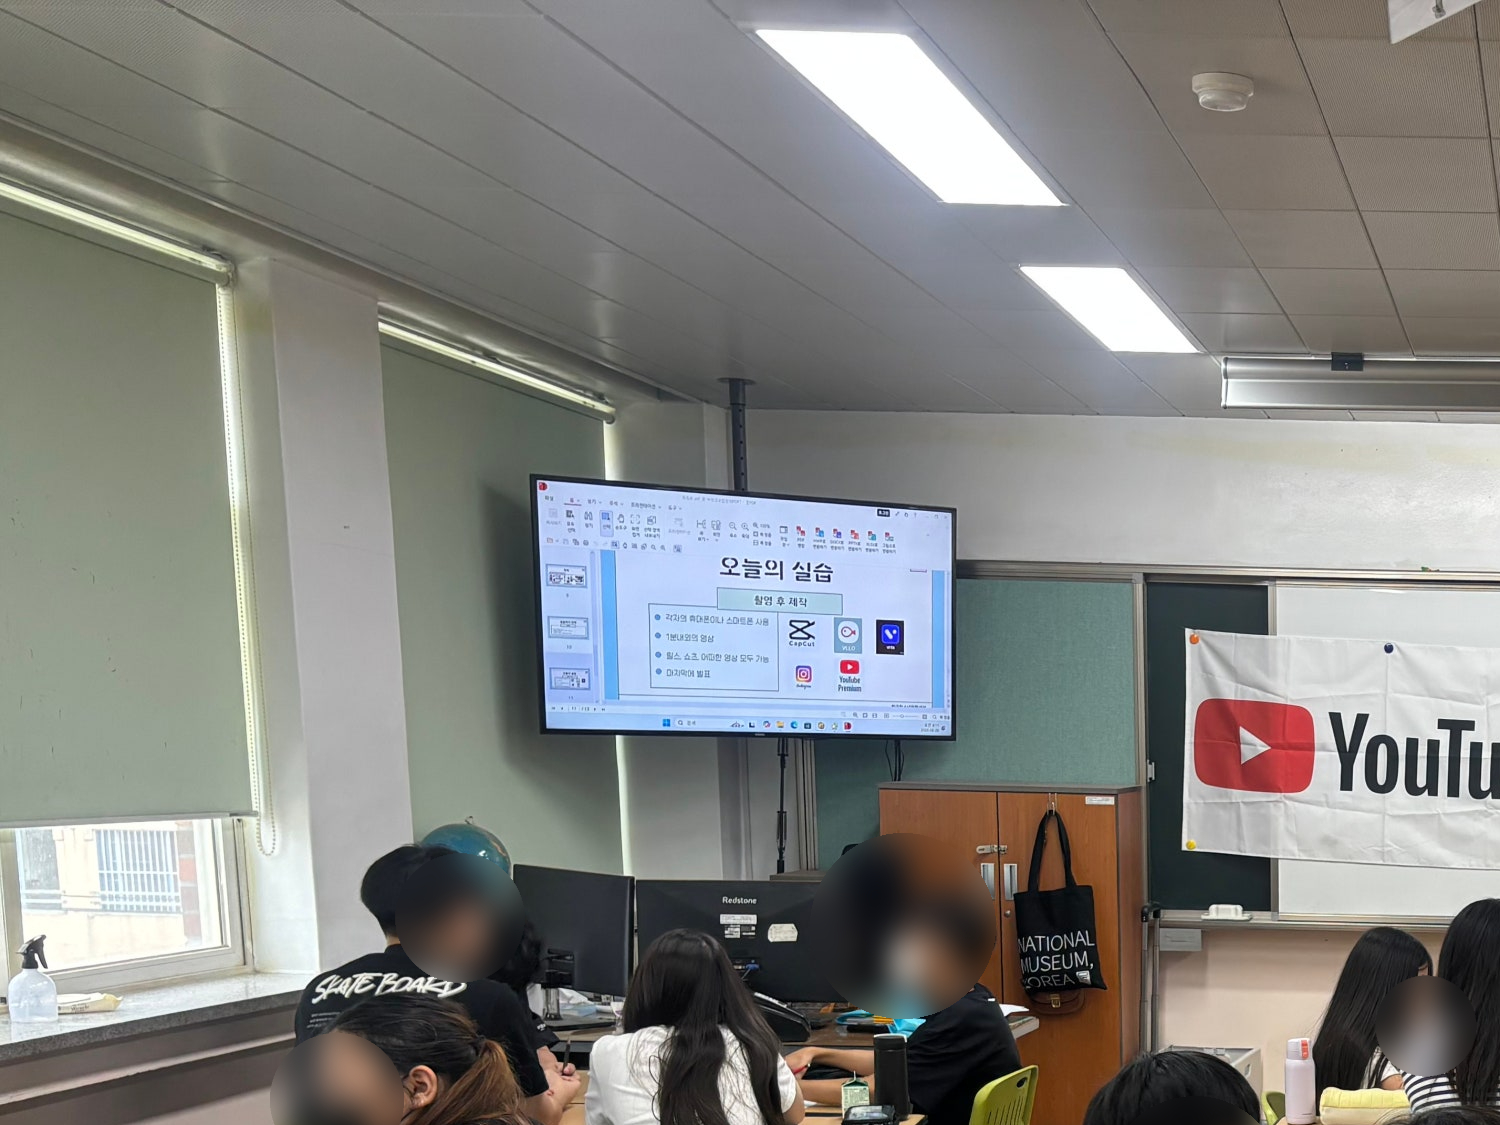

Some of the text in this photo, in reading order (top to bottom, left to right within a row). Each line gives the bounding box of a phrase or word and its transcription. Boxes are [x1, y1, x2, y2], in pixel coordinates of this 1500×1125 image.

[720, 557, 833, 583] 오늘의 실습
[754, 595, 808, 607] 촬영 후 제작
[665, 614, 769, 626] 각자의 휴대폰이나 스마트폰 사용
[666, 633, 714, 642] 1분내외의 영상
[701, 653, 722, 661] 어떠한
[724, 654, 738, 662] 영상
[739, 654, 754, 662] 모두
[756, 655, 769, 663] 가능
[666, 668, 710, 678] 마지막에 발표
[839, 676, 861, 684] YouTube
[838, 684, 862, 692] Premium
[722, 896, 757, 904] Redstone
[1018, 929, 1095, 953] NATIONAL
[1020, 950, 1094, 974] MUSEUM,
[311, 972, 468, 1004] SKATE BOARD
